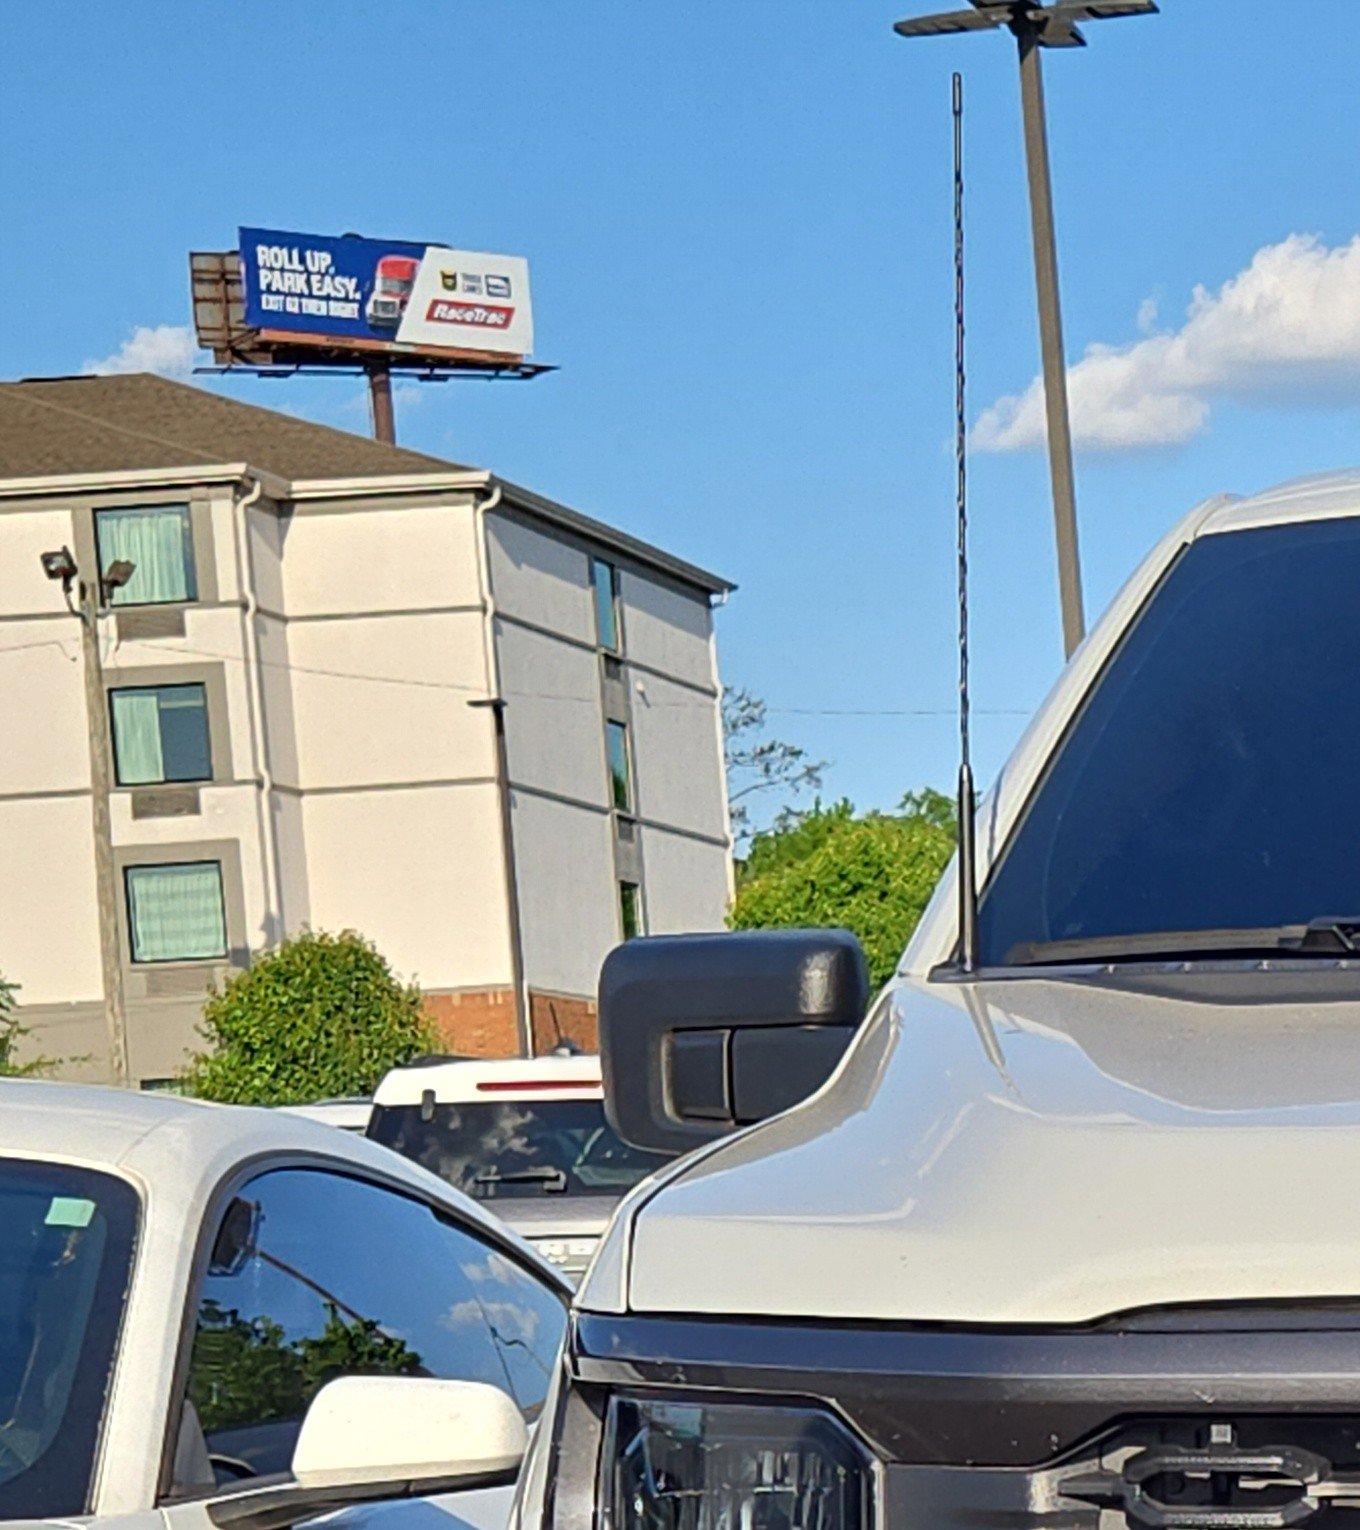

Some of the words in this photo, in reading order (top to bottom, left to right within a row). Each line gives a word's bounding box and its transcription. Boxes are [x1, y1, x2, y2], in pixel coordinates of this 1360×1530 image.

[256, 244, 304, 271] ROLL
[305, 249, 335, 275] UP.
[259, 268, 309, 295] PARK
[310, 273, 361, 300] EASY.
